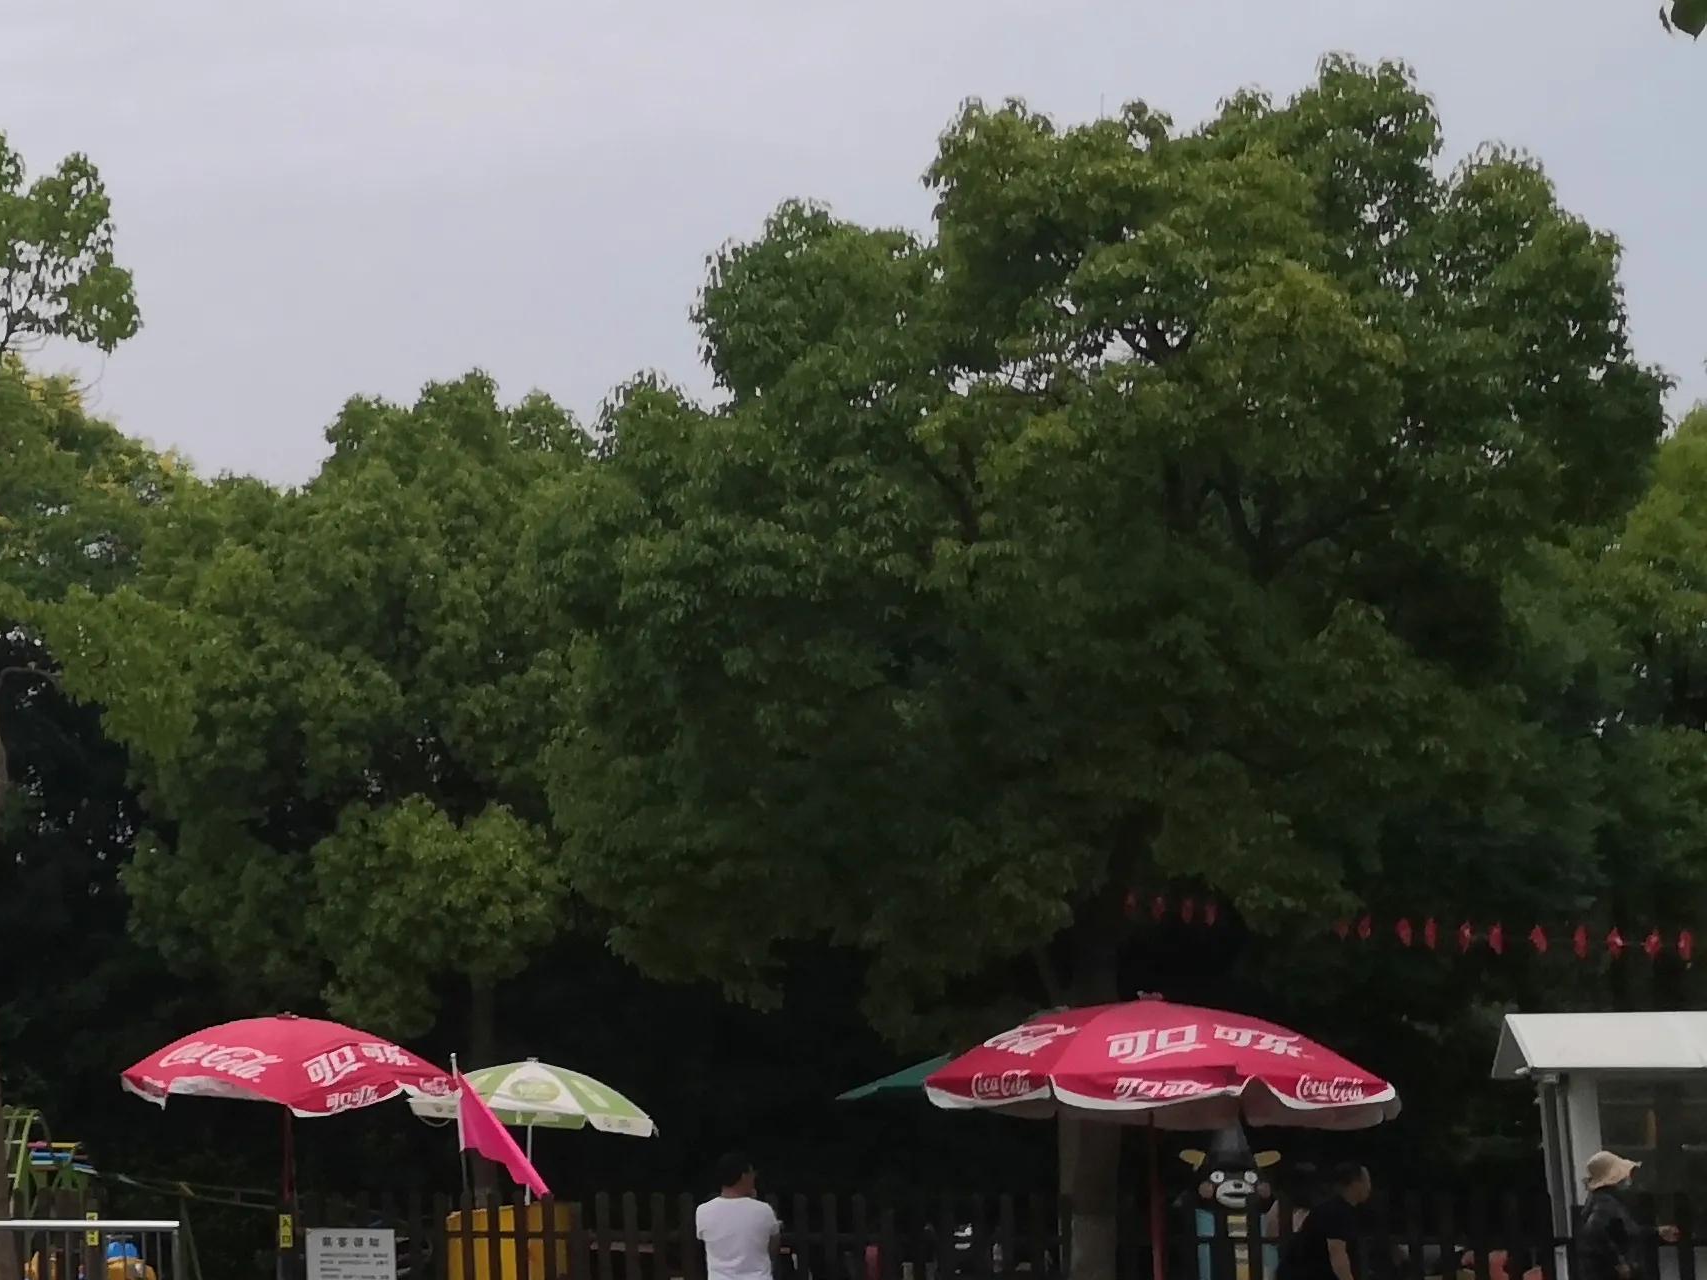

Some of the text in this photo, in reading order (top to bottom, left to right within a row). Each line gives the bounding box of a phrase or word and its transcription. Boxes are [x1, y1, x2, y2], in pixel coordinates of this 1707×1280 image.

[302, 1042, 418, 1087] 可口可乐
[1106, 1024, 1302, 1064] 可口可乐
